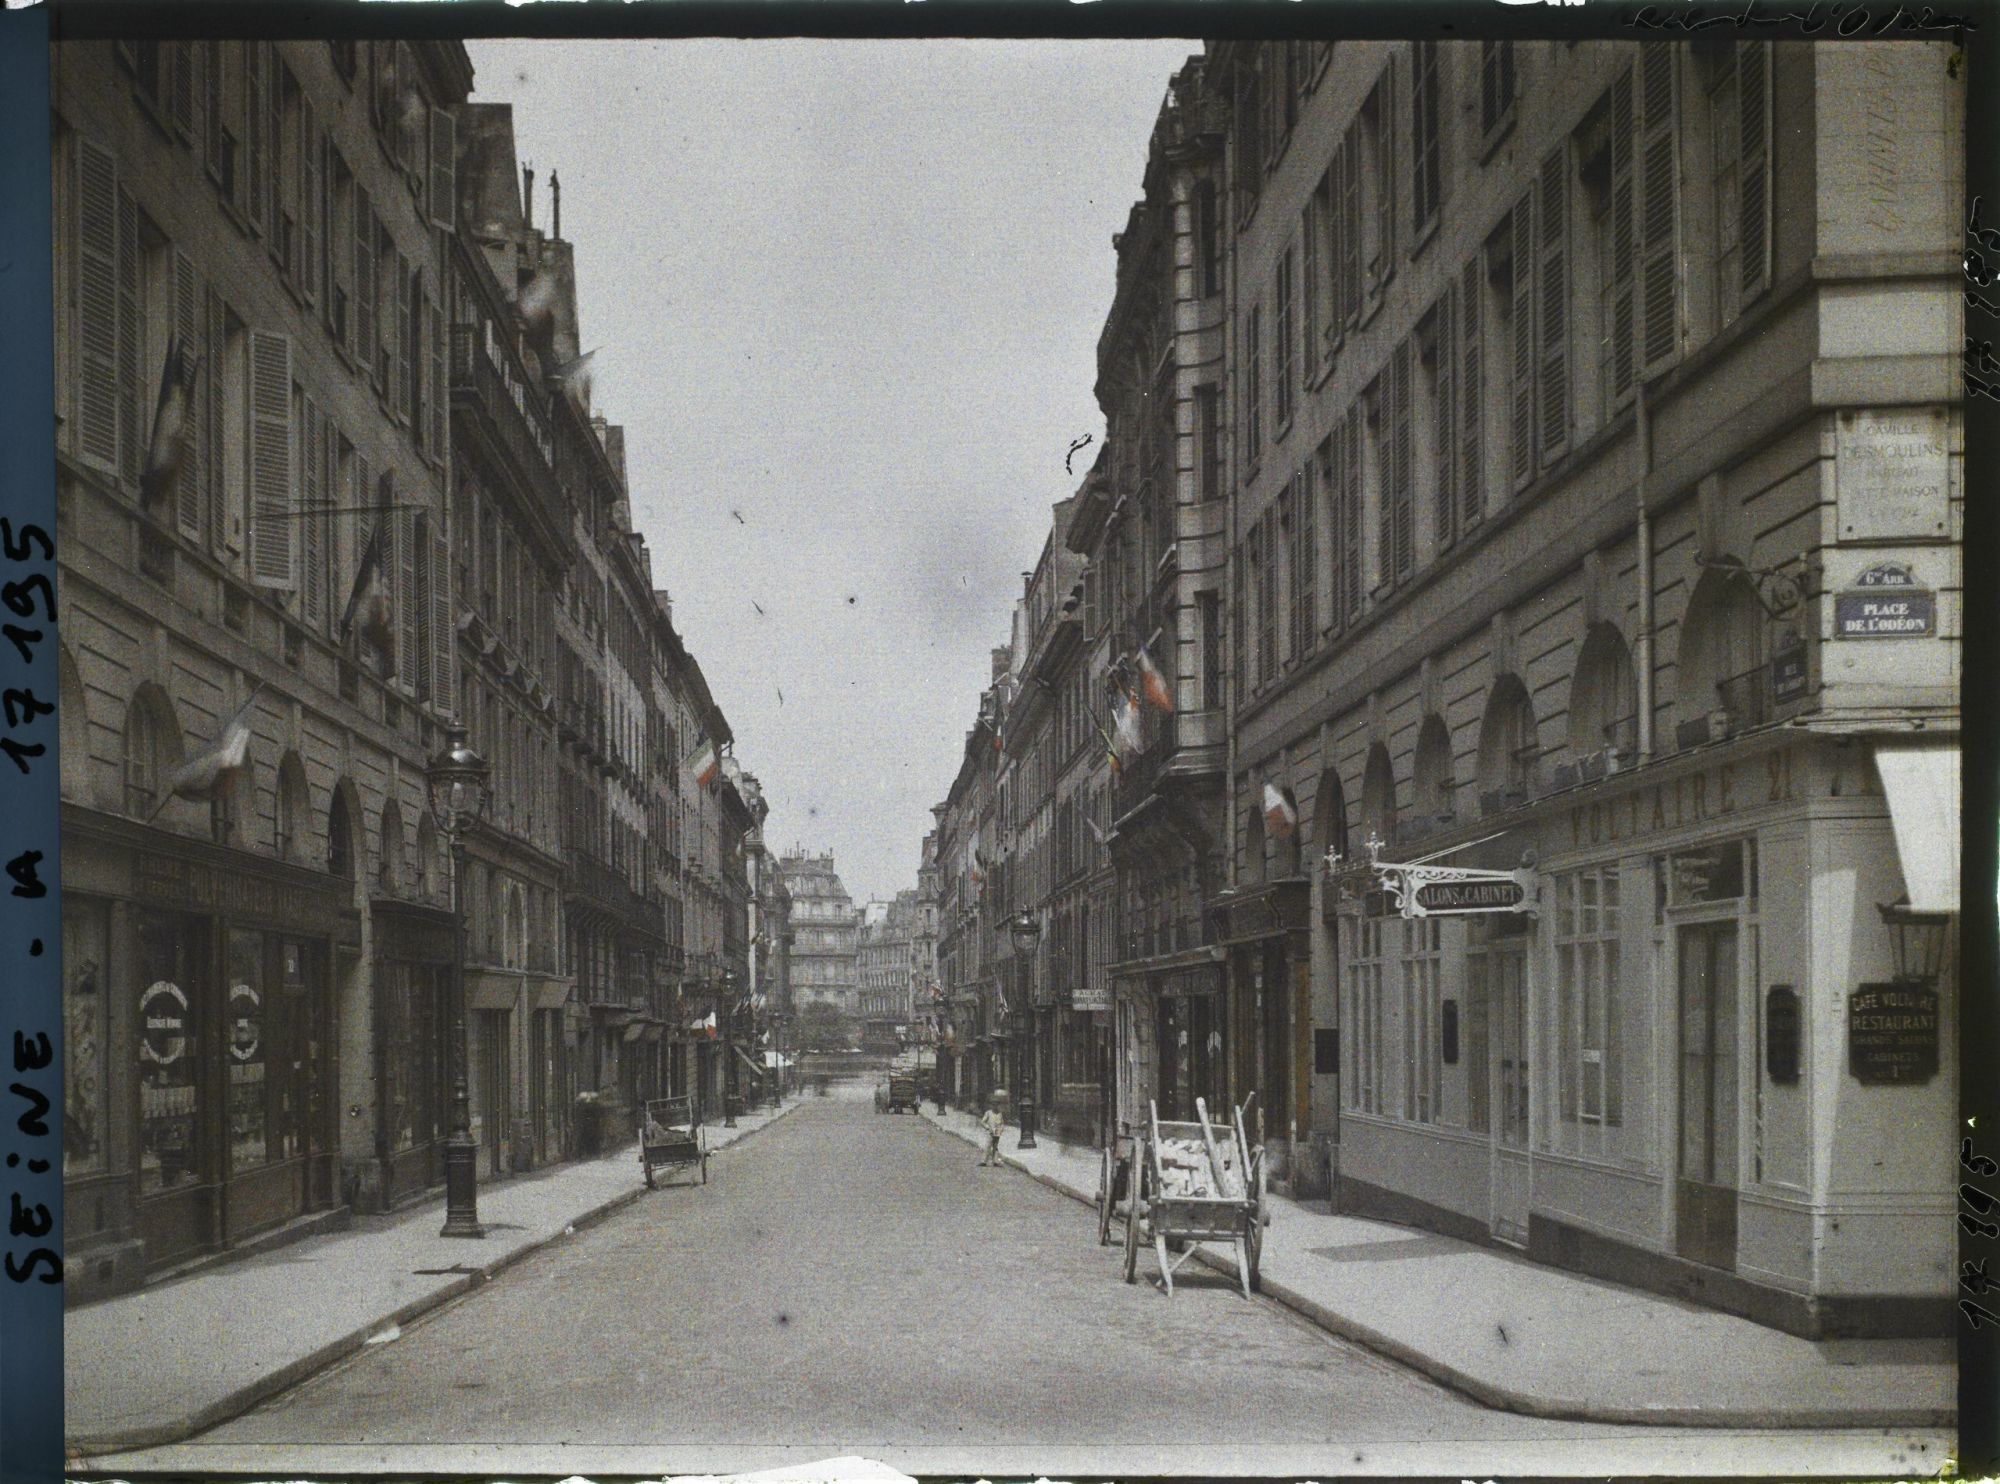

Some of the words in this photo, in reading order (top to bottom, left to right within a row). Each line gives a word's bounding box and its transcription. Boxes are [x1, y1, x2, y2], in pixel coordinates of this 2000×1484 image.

[1864, 603, 1909, 616] PLACE
[1846, 620, 1865, 632] DE
[1571, 763, 1736, 845] VOLTAIRE
[1852, 991, 1879, 1012] CAFÉ
[1852, 1015, 1935, 1031] RESTAURANT
